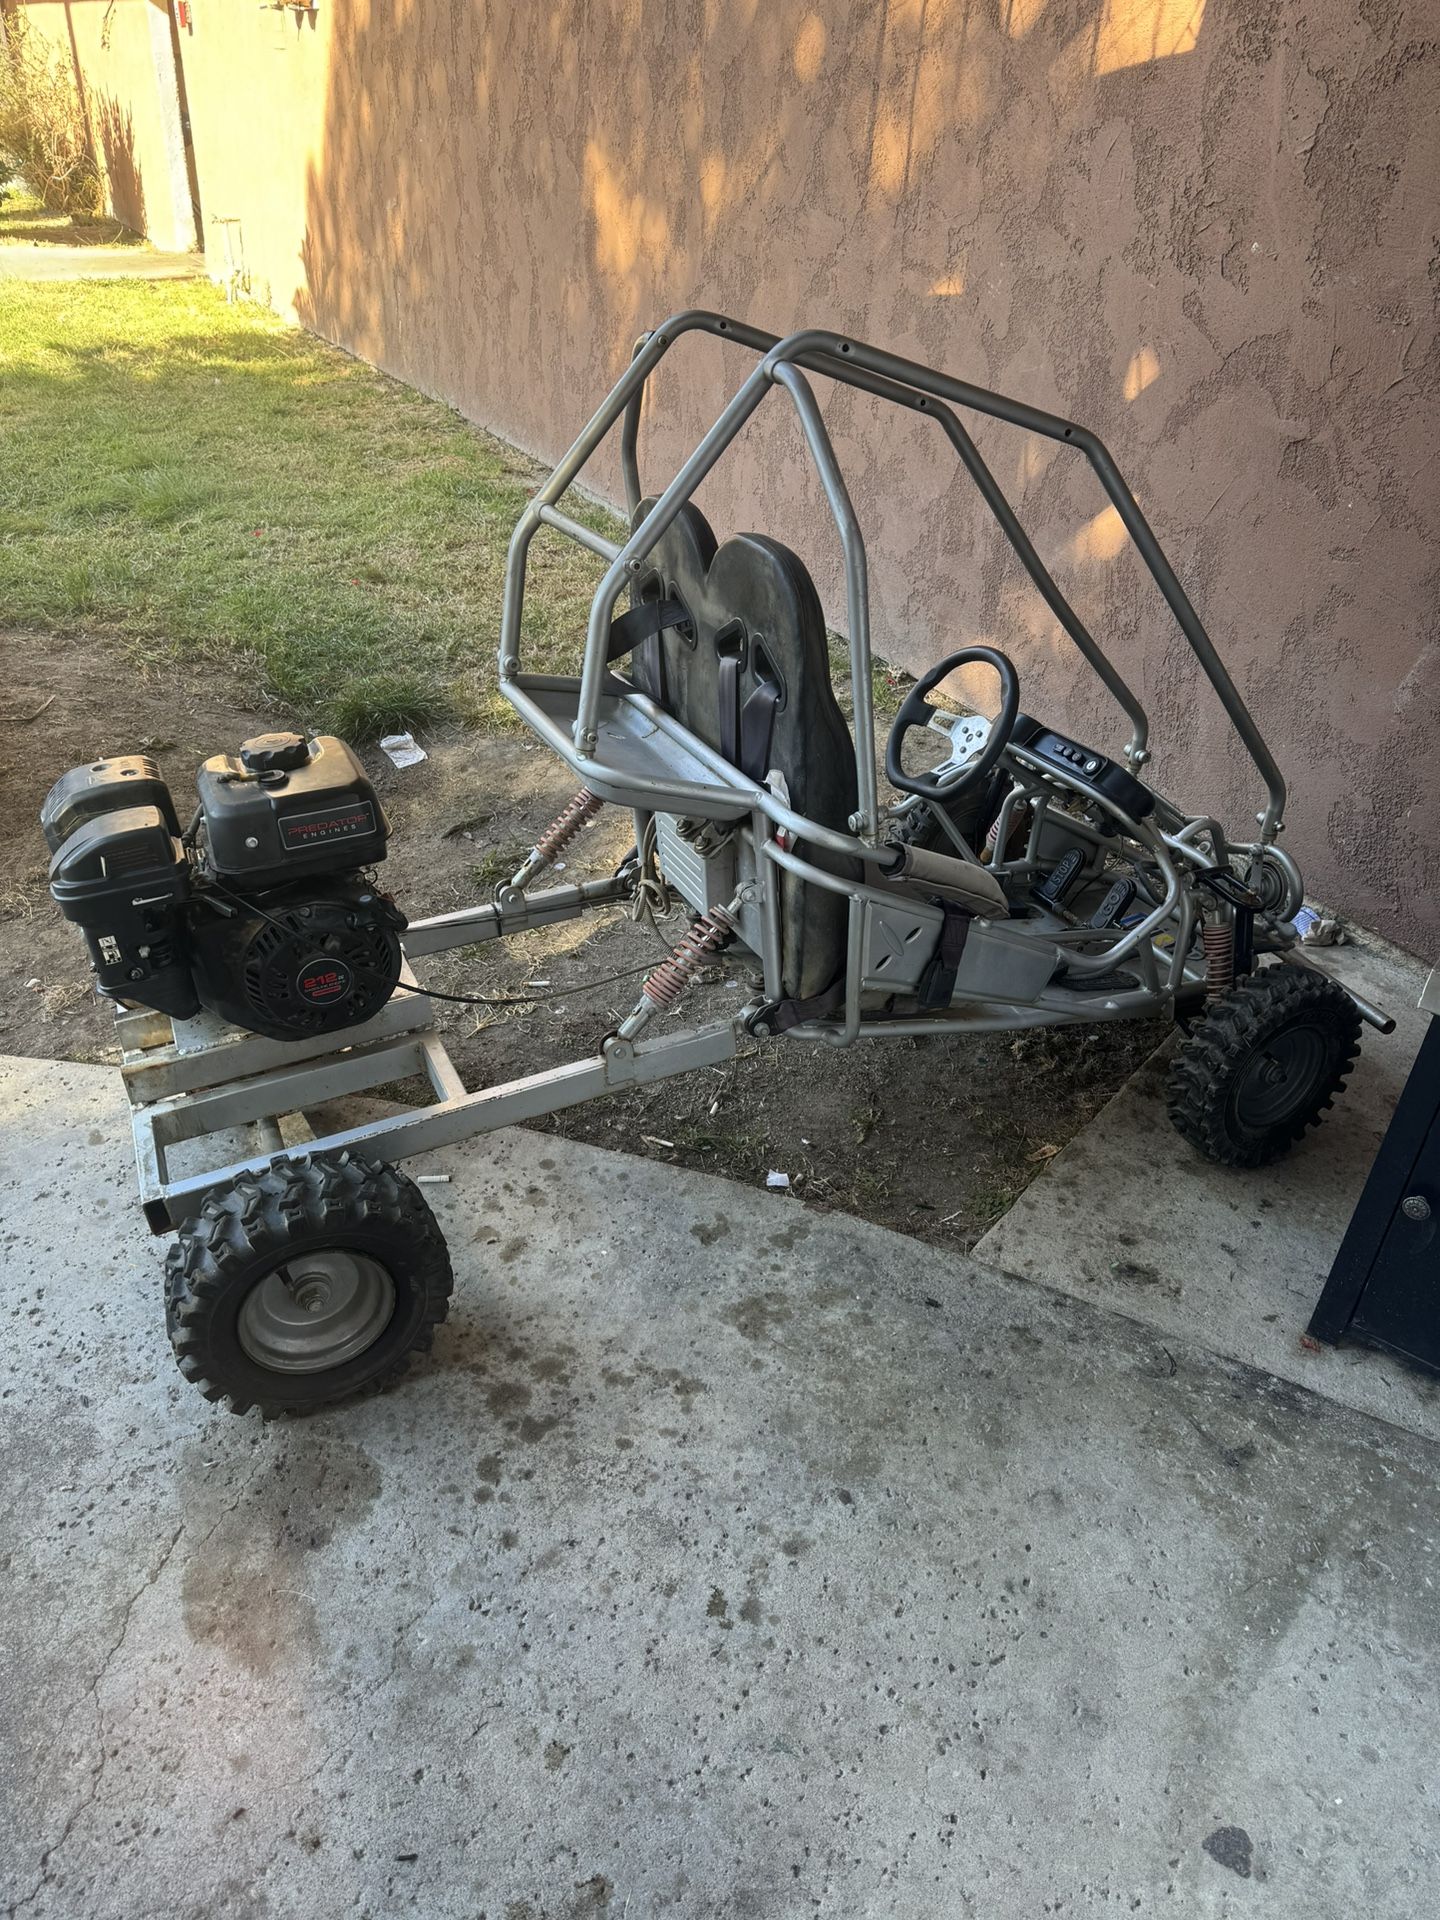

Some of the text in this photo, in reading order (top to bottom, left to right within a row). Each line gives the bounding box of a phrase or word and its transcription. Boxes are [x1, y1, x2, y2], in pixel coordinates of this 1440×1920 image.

[288, 815, 367, 836] PREDATOR
[303, 824, 356, 839] ENGINES
[1052, 860, 1070, 883] STOP
[1103, 893, 1120, 916] GO
[304, 972, 337, 988] 212
